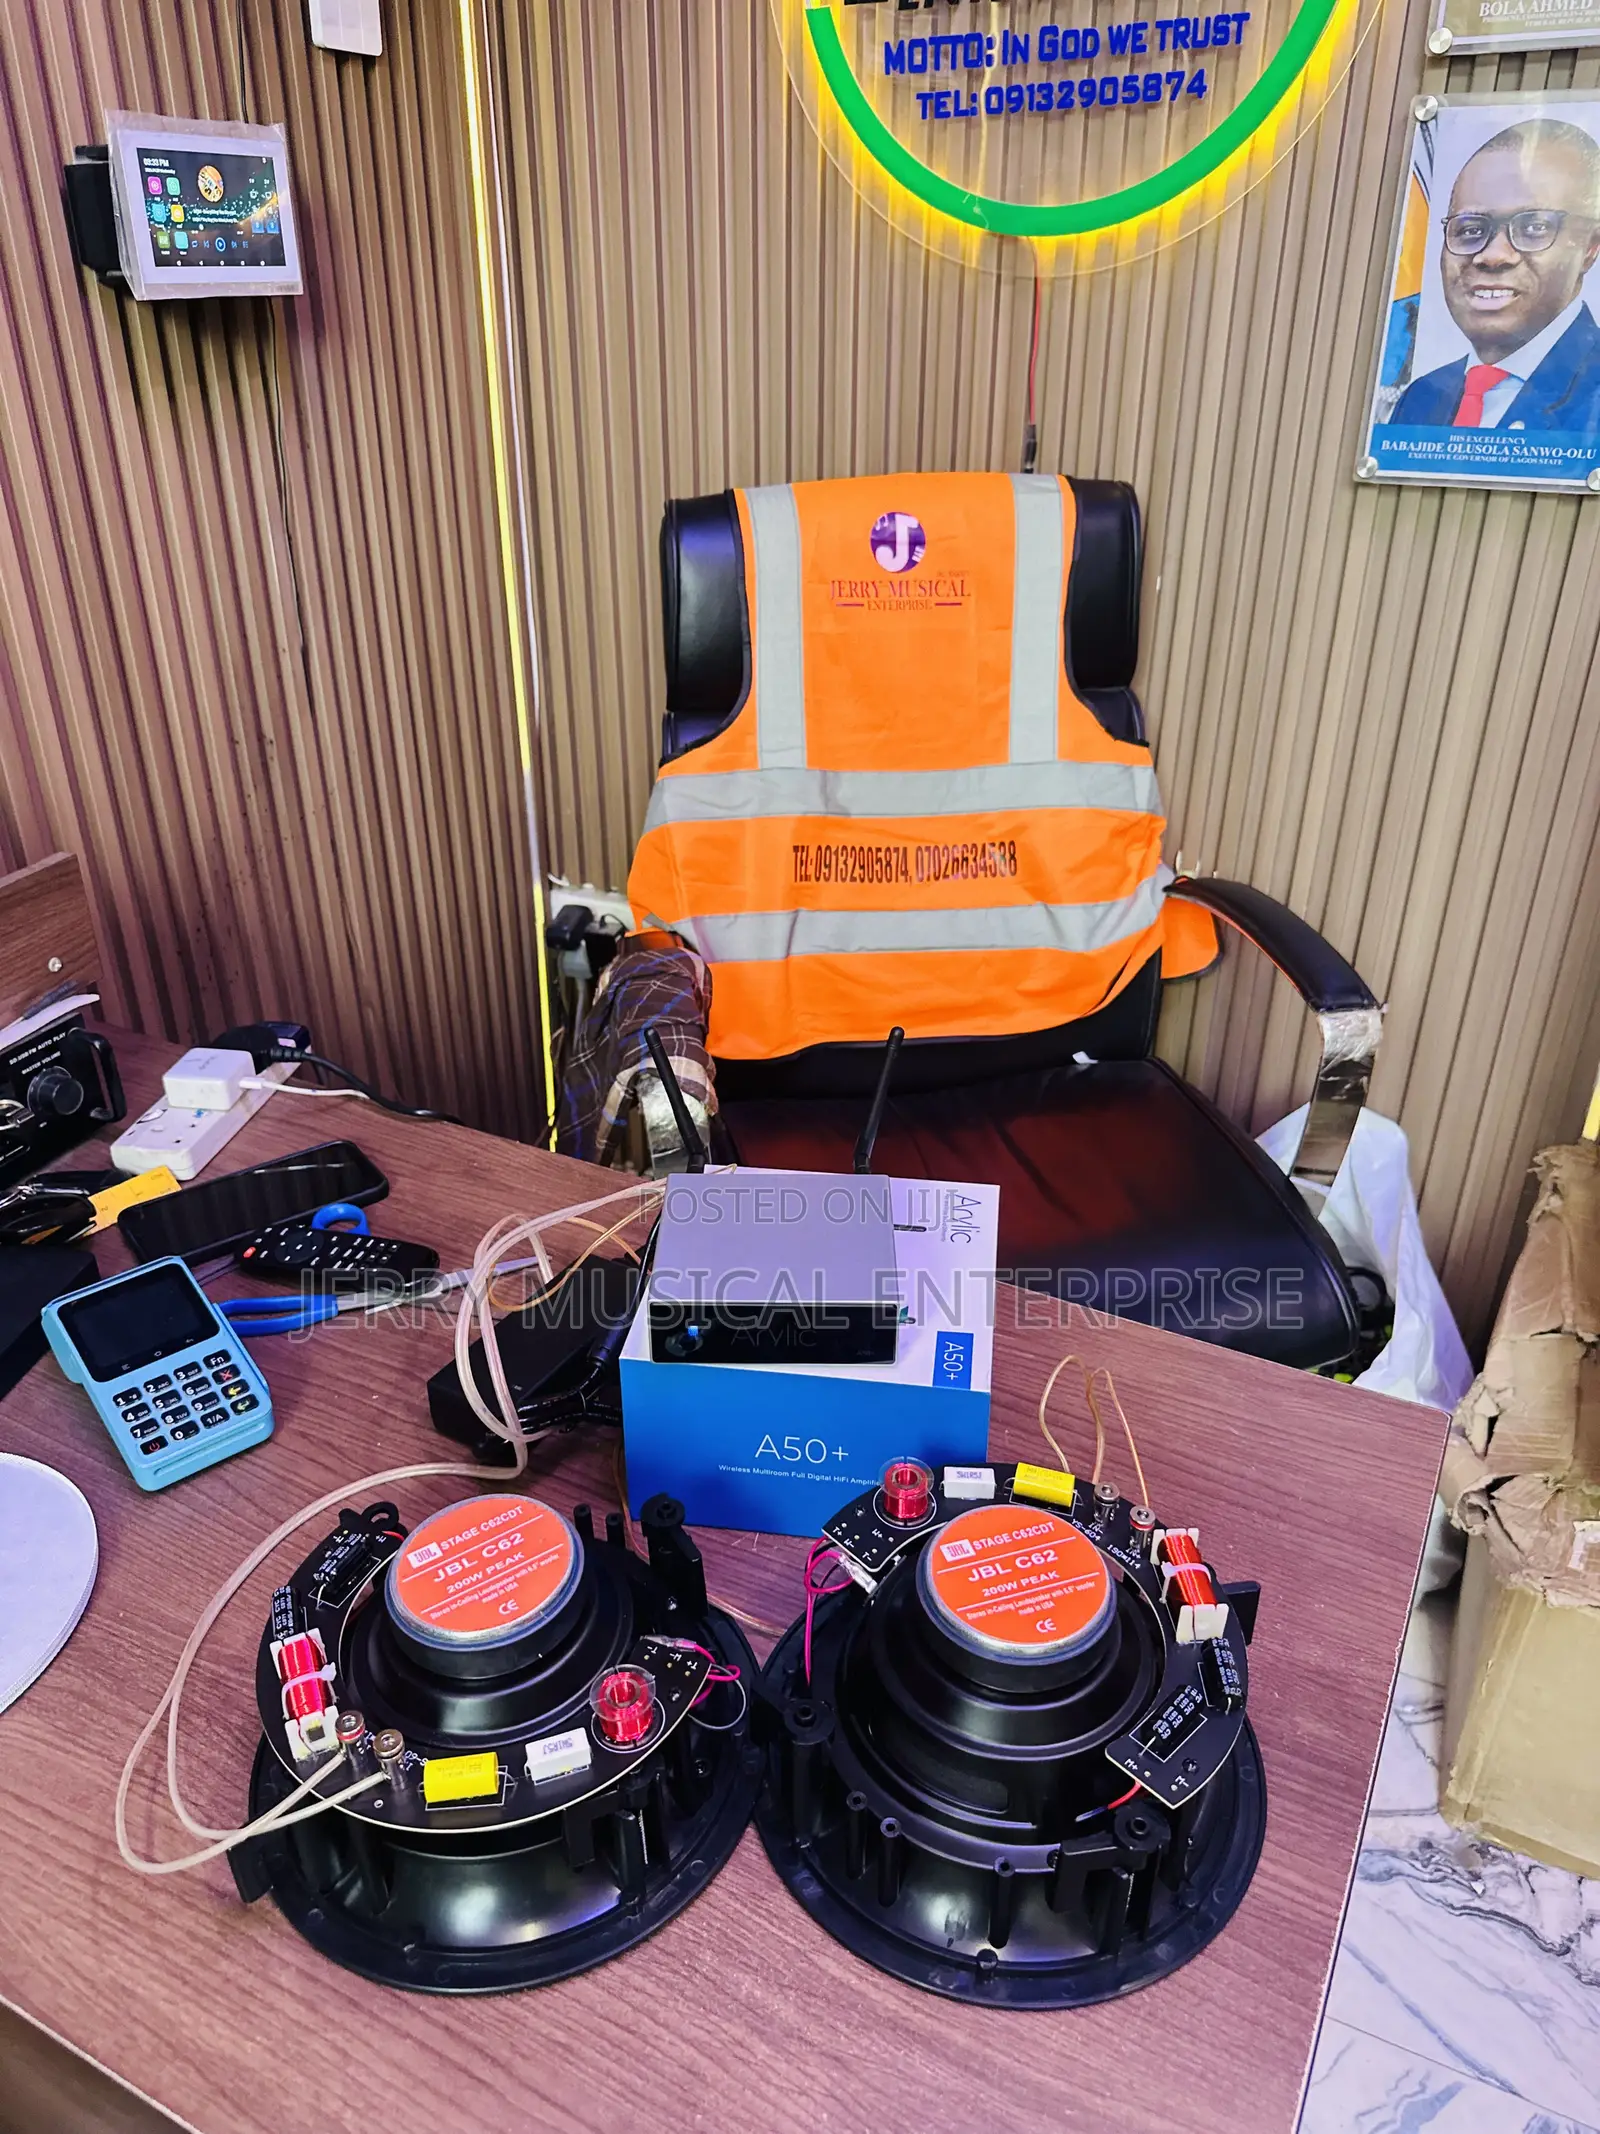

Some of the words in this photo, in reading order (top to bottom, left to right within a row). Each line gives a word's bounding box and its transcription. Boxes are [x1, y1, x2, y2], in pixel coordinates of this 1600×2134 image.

[1479, 0, 1524, 17] BOLA
[1528, 0, 1593, 13] AHMED
[884, 33, 995, 76] MOTTO:
[1108, 22, 1148, 57] WE
[1156, 12, 1250, 52] TRUST
[916, 91, 978, 120] TEL:
[985, 69, 1207, 115] 09132905874
[1466, 435, 1527, 445] EXCELLENCY
[1381, 440, 1444, 453] BABAJIDE
[1447, 443, 1510, 456] OLUSOLA
[1512, 446, 1597, 460] SANWO-OLU
[1408, 452, 1451, 461] EXECUTIVE
[1452, 454, 1498, 463] GOVERNOR
[1498, 456, 1508, 464] OF
[1511, 457, 1538, 465] LAGOS
[1538, 458, 1564, 466] STATE
[830, 580, 879, 600] JERRY
[888, 579, 971, 598] MUSICAL
[867, 599, 932, 611] ENTERPRISE
[53, 1031, 66, 1042] PLAY
[41, 1051, 61, 1064] VOLUME
[950, 1194, 981, 1244] Arylic
[210, 1355, 225, 1367] Fn
[943, 1341, 965, 1381] A50+
[177, 1371, 186, 1380] 3
[146, 1384, 156, 1393] 2
[185, 1386, 194, 1396] 6
[116, 1397, 126, 1406] 1
[155, 1399, 164, 1408] 5
[194, 1402, 203, 1411] 9
[126, 1412, 135, 1422] 4
[165, 1414, 174, 1424] 8
[175, 1411, 188, 1420] TUV
[133, 1428, 142, 1438] 7
[755, 1434, 849, 1464] A50+
[718, 1464, 751, 1474] Wireless
[752, 1467, 790, 1477] Multiroom
[791, 1471, 806, 1479] Full
[807, 1473, 832, 1482] Digital
[833, 1475, 849, 1483] HiFi
[850, 1477, 882, 1487] Amplifie
[414, 1546, 438, 1564] JBL
[440, 1526, 480, 1551] STAGE
[480, 1505, 524, 1532] C62CDT
[946, 1543, 970, 1558] JBL
[972, 1533, 1012, 1551] STAGE
[1011, 1521, 1055, 1541] C62CDT
[434, 1556, 478, 1583] JBL
[481, 1532, 525, 1558] C62
[968, 1563, 1012, 1582] JBL
[1015, 1549, 1059, 1569] C62
[446, 1573, 484, 1595] 200W
[485, 1551, 526, 1576] PEAK
[504, 1581, 520, 1595] USA
[982, 1580, 1018, 1597] 200W
[1020, 1570, 1060, 1587] PEAK
[1041, 1600, 1056, 1611] USA
